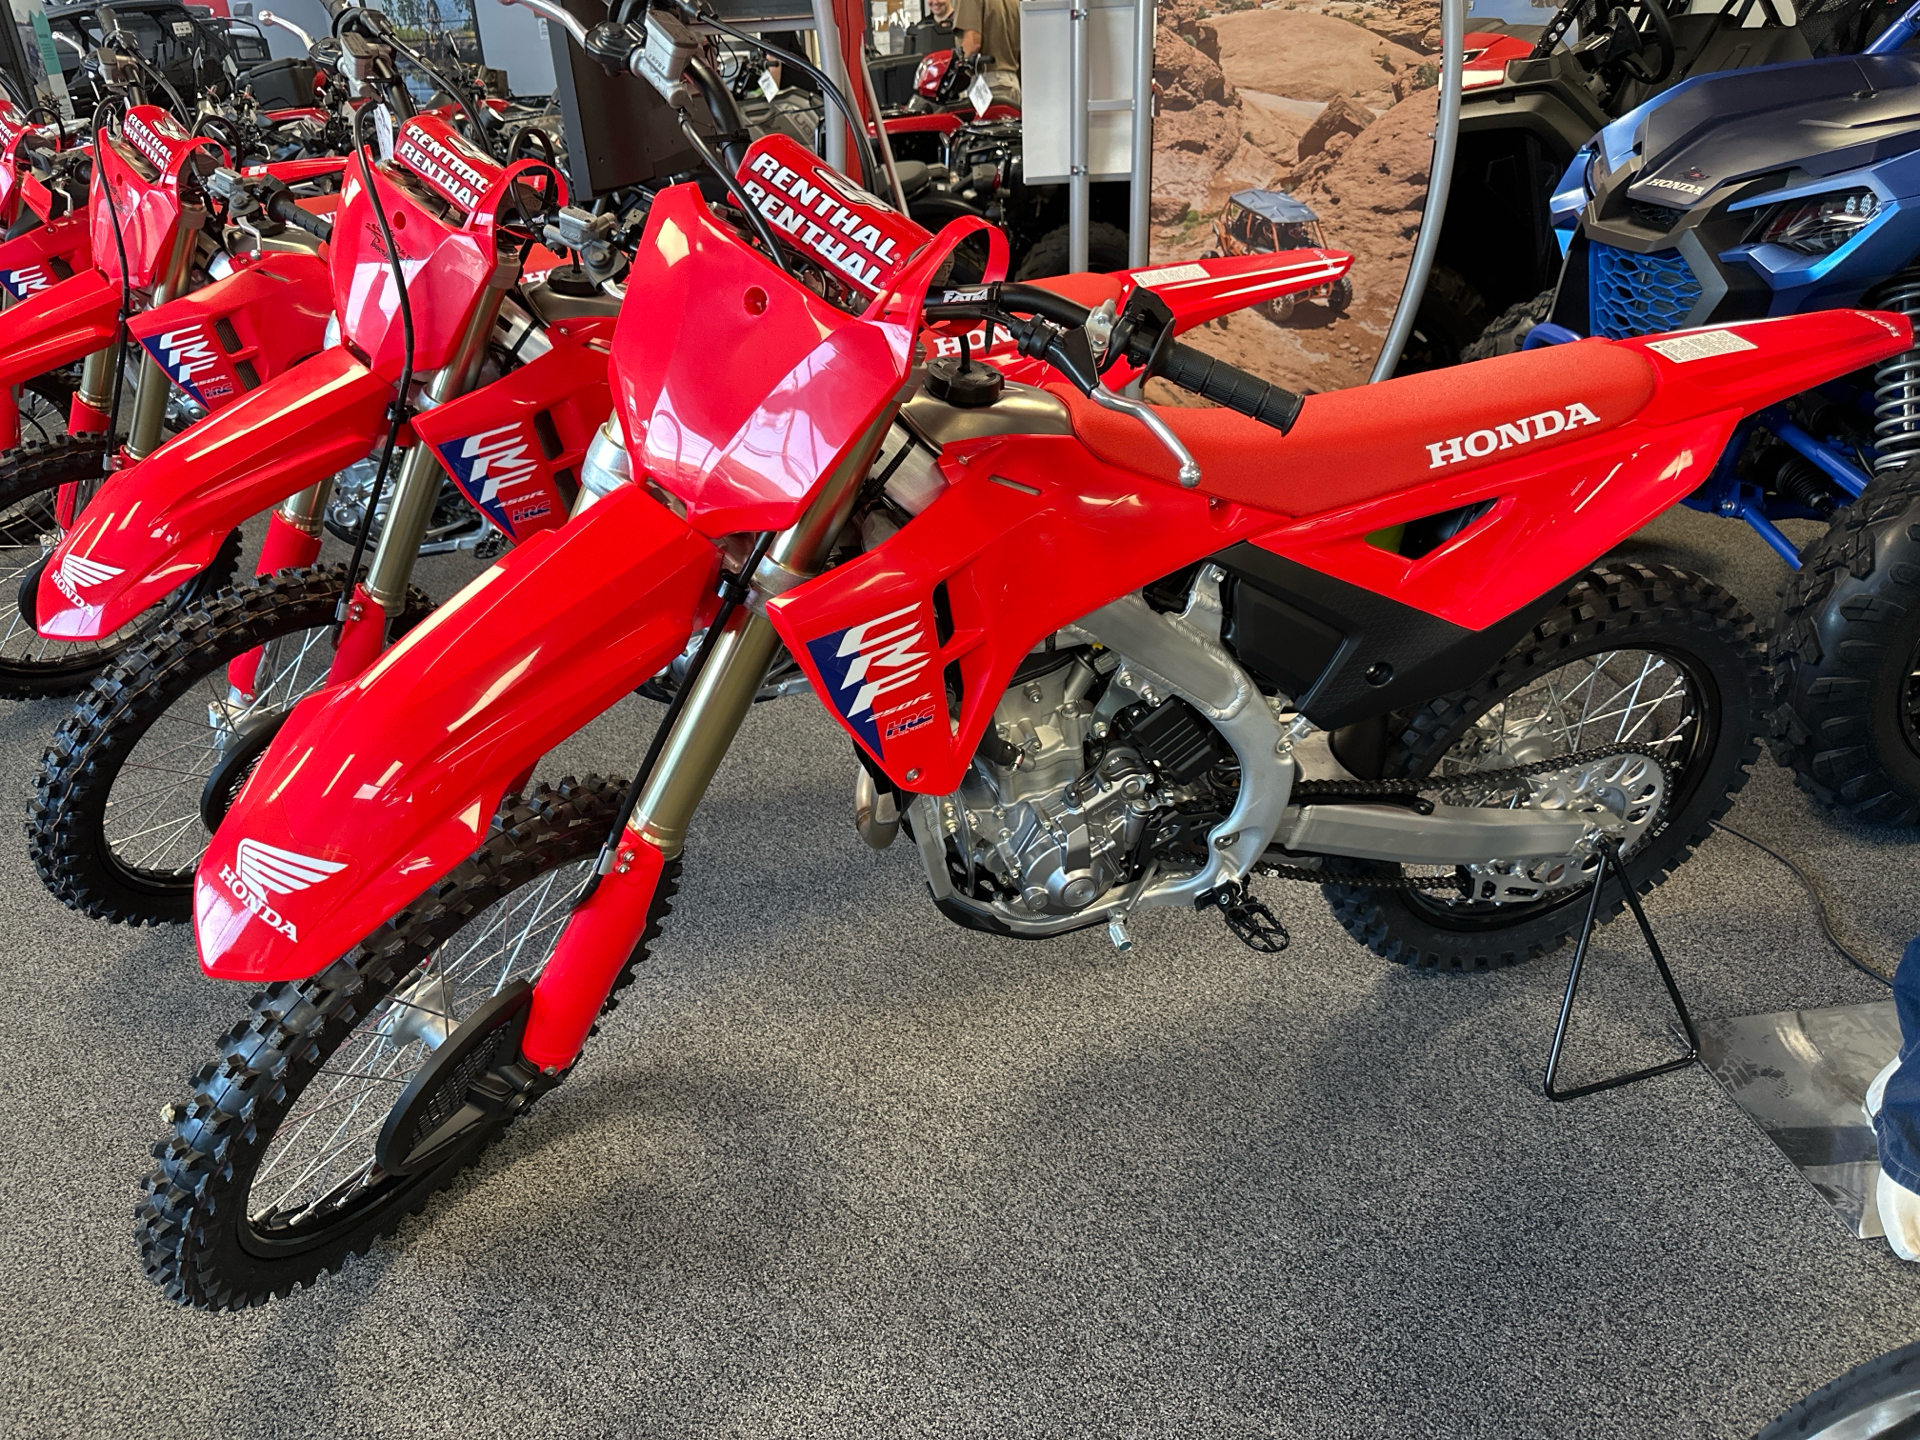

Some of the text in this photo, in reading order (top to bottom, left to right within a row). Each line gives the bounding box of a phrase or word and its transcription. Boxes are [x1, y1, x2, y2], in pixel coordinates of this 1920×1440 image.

[128, 113, 173, 162] RENTHAL
[403, 124, 488, 193] RENTHAL
[750, 152, 897, 266] RENTHAL
[1646, 178, 1705, 196] HONDA
[743, 180, 883, 294] RENTHAL
[159, 323, 219, 384] CRF
[933, 325, 1014, 357] HON
[460, 421, 538, 505] CRF
[1425, 402, 1600, 469] HONDA
[493, 489, 547, 509] 450R
[512, 500, 551, 522] HRC
[51, 569, 95, 618] HONDA
[835, 600, 932, 719] CRF
[865, 691, 934, 723] 250R
[886, 704, 936, 738] HRC
[218, 863, 298, 944] HONDA
